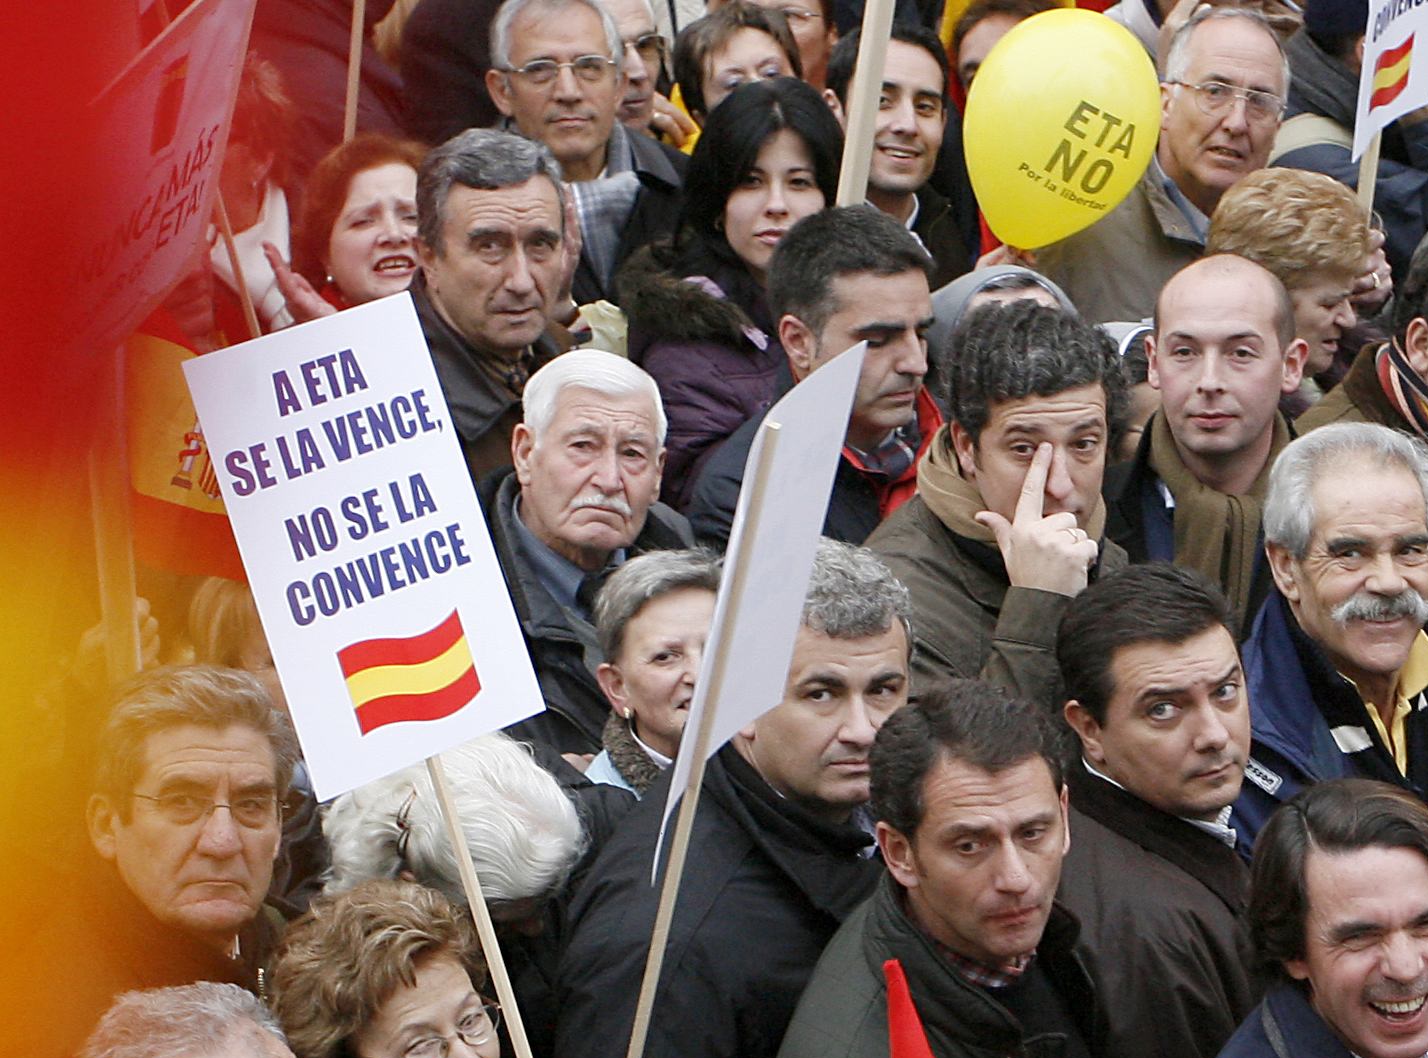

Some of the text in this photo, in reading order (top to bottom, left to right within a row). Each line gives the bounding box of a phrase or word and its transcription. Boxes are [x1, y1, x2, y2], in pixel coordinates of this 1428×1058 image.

[1063, 100, 1136, 160] ETA
[1019, 162, 1043, 182] Por
[1044, 179, 1057, 192] la
[1044, 138, 1114, 195] NO
[272, 349, 368, 417] A ETA
[225, 389, 443, 497] SE LA VENCE,
[285, 473, 438, 562] NO SE LA
[286, 522, 472, 627] CONVENCE
